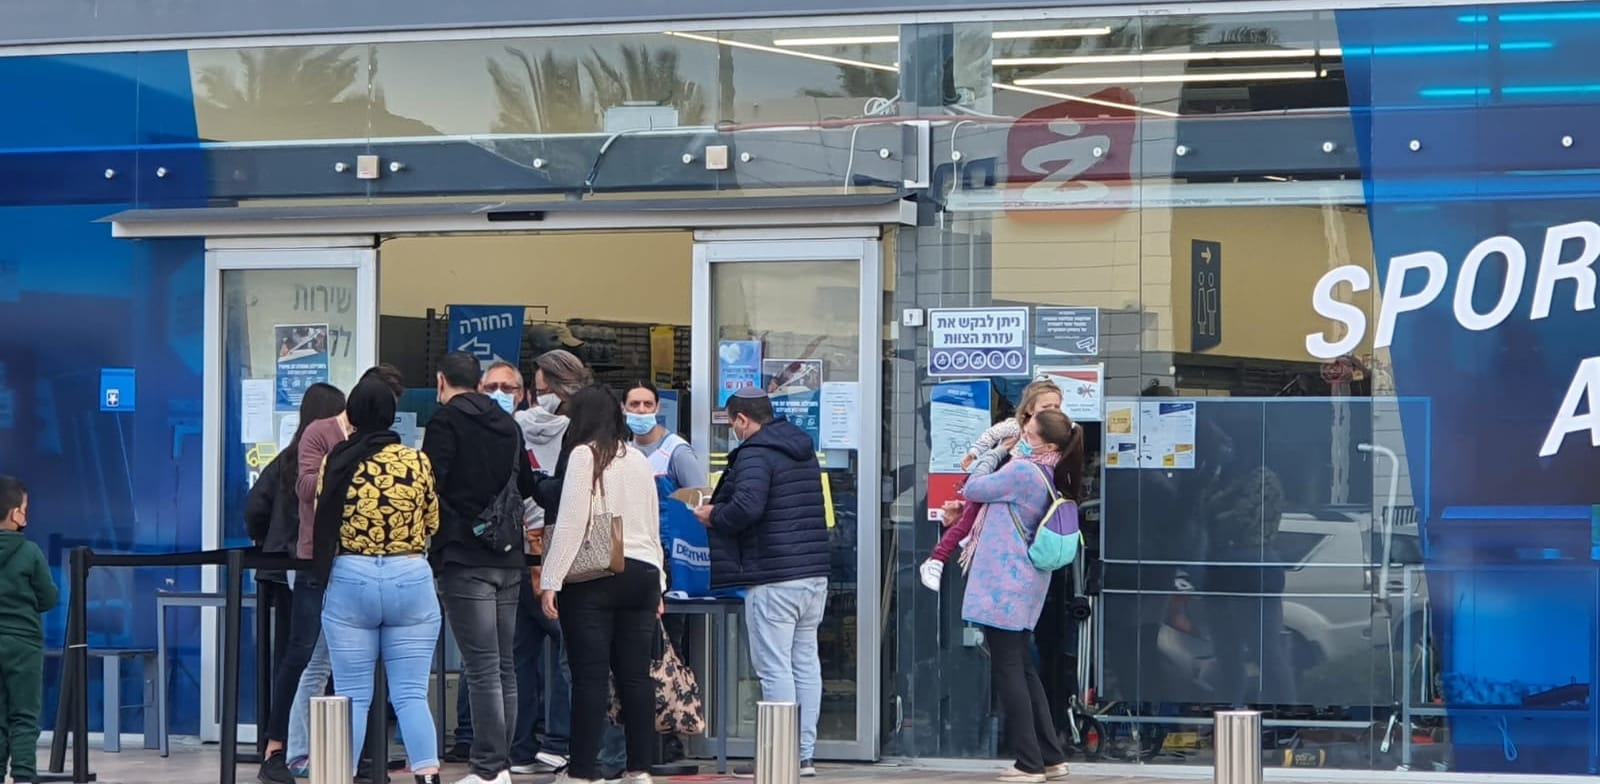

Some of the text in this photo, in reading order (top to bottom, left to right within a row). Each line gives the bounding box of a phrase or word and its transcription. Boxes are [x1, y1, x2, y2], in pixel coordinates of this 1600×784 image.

[293, 284, 352, 314] שירות
[459, 312, 513, 335] החזרה
[937, 314, 1020, 331] ניתן לבקש את
[943, 332, 1014, 345] עזרת הצוות
